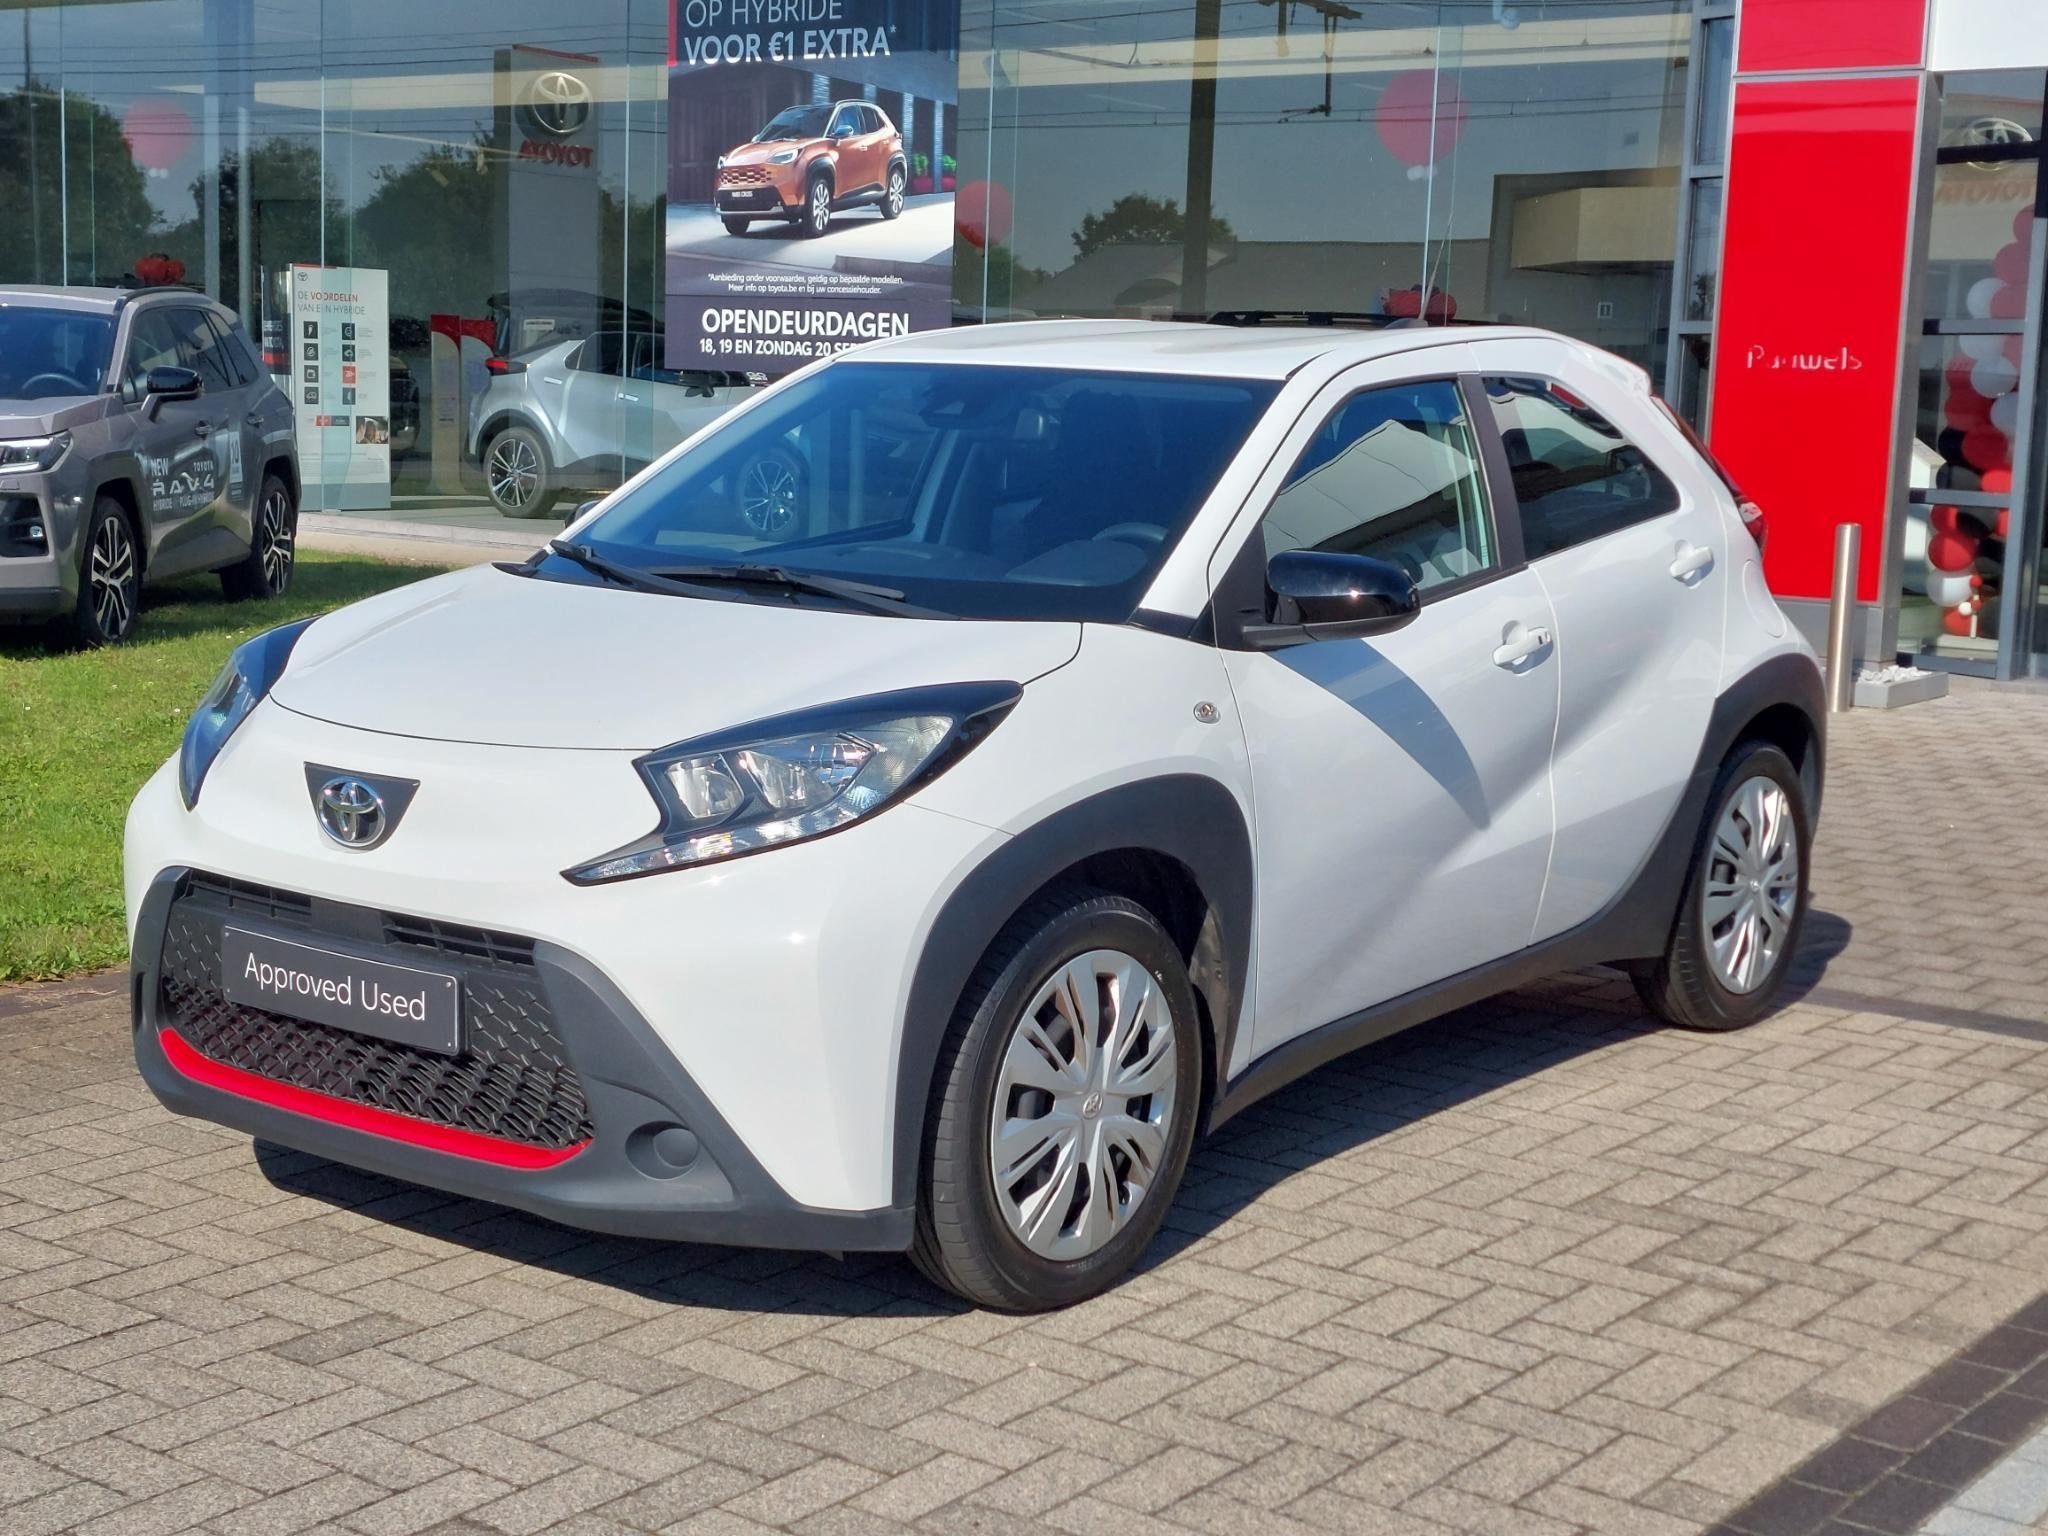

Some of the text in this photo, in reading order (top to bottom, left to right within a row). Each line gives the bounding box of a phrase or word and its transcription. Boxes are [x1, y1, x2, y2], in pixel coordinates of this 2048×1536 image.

[685, 0, 843, 28] OP HYBRIDE
[684, 33, 762, 65] VOOR
[768, 31, 795, 62] €1
[728, 283, 744, 292] Meer
[745, 283, 757, 292] info
[758, 285, 767, 293] op
[768, 284, 798, 293] toyota.be
[807, 284, 815, 294] bij
[746, 274, 764, 282] onder
[808, 274, 828, 285] geldig
[829, 276, 839, 284] op
[840, 274, 870, 285] bepaalde
[297, 290, 359, 302] DE VOORDELEN
[297, 303, 366, 315] VAN EN HYBRIDE
[702, 308, 910, 338] OPENDEURDAGEN
[700, 338, 717, 355] 18,
[719, 338, 733, 353] 19
[735, 339, 753, 354] EN
[755, 340, 813, 356] ZONDAG
[815, 341, 832, 356] 20
[151, 458, 169, 476] NEW
[193, 460, 214, 472] TOYOTA
[244, 952, 426, 1021] Approved Used
